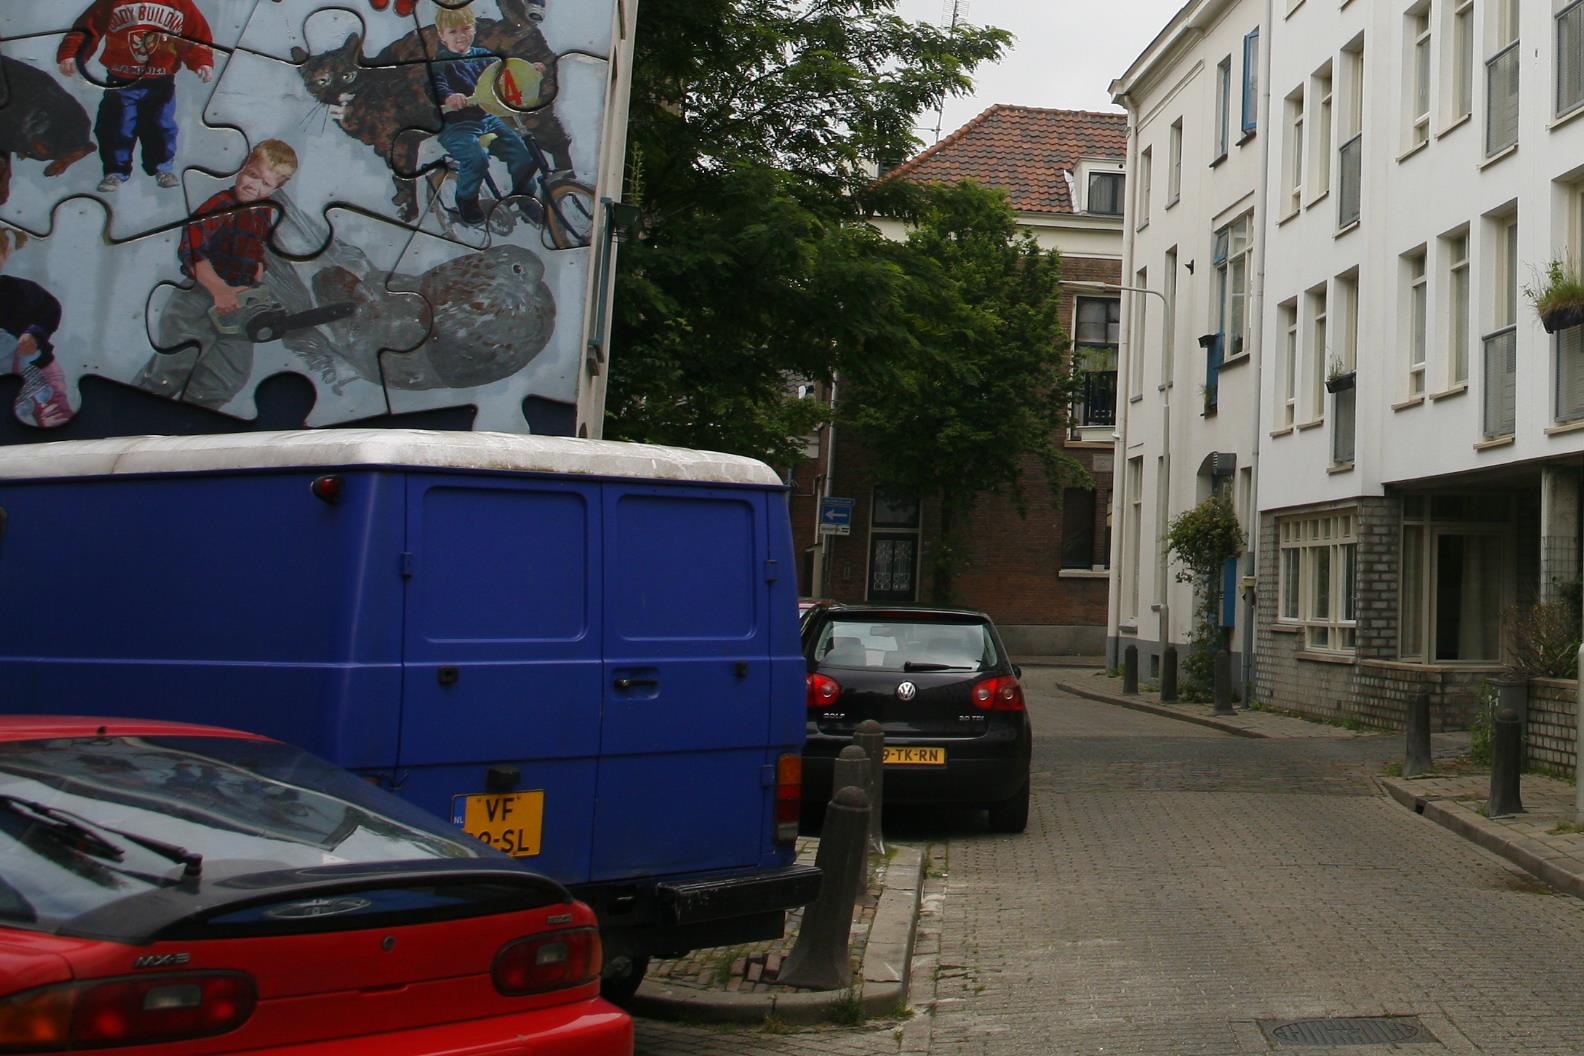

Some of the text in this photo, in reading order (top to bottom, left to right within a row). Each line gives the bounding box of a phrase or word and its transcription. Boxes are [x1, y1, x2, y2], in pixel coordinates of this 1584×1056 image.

[503, 68, 523, 107] 4
[882, 749, 939, 762] 9-TK-RN
[486, 797, 516, 823] VF
[453, 816, 464, 824] NL
